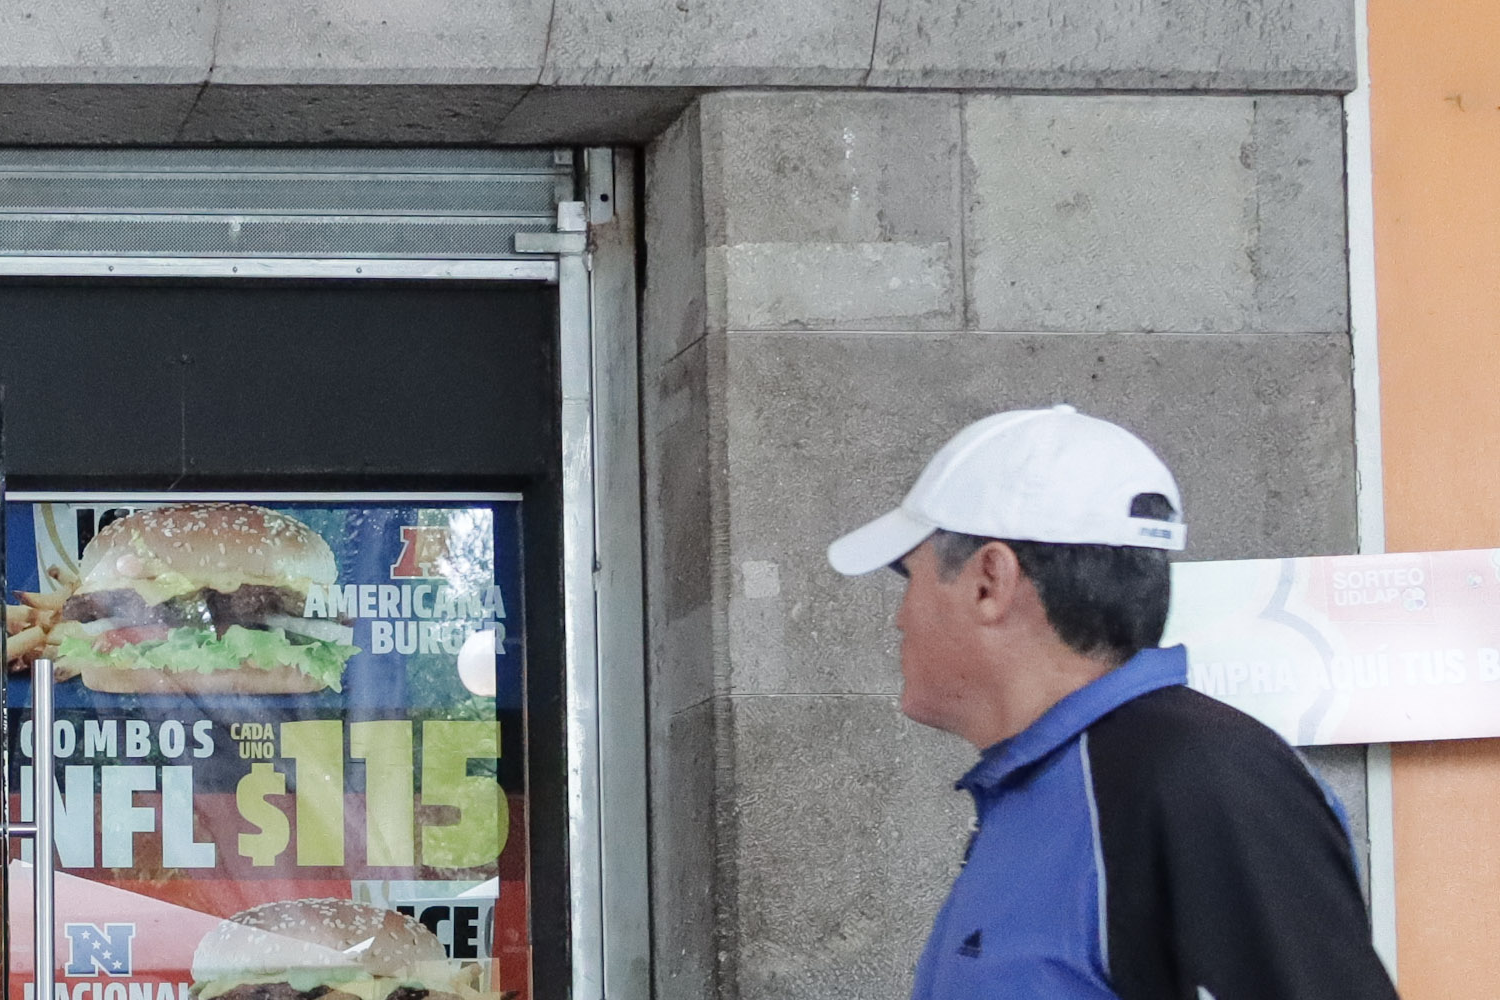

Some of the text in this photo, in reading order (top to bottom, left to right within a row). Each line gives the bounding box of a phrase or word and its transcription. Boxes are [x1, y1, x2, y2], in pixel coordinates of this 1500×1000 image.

[1332, 567, 1425, 591] SORTEO
[304, 584, 507, 619] AMERICANA
[1334, 589, 1401, 607] UDLAP
[371, 620, 507, 656] BURGER
[1306, 644, 1389, 691] AQUÍ
[1399, 649, 1466, 687] TUS
[230, 722, 275, 743] CADA
[238, 741, 275, 760] UNO
[235, 720, 510, 869] $115
[20, 765, 216, 869] NFL
